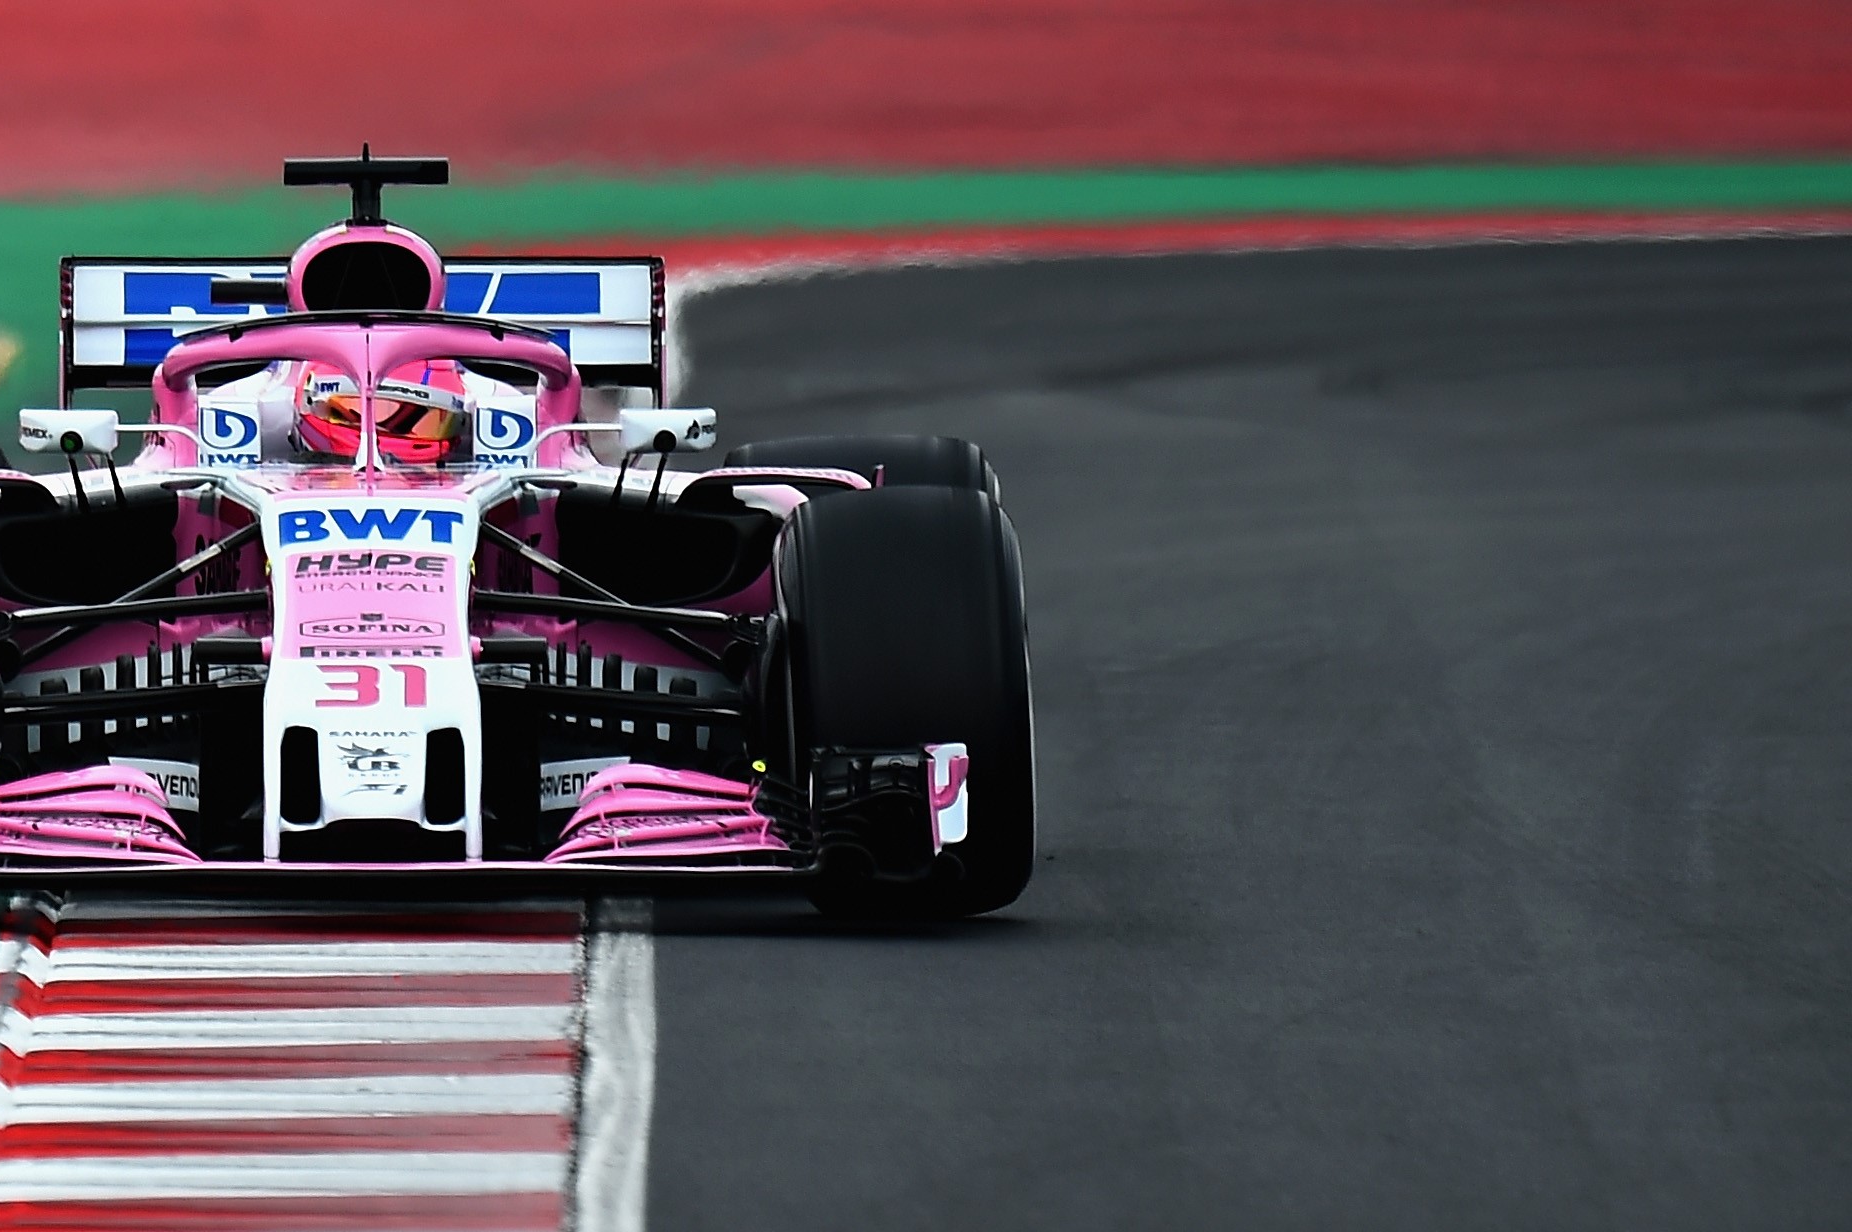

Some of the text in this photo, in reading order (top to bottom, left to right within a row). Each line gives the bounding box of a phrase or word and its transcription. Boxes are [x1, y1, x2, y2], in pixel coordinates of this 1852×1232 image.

[278, 508, 463, 547] BWT
[296, 553, 447, 573] HYPE
[298, 582, 444, 593] URALKALI
[311, 624, 434, 634] SOFINA
[315, 664, 427, 708] 31
